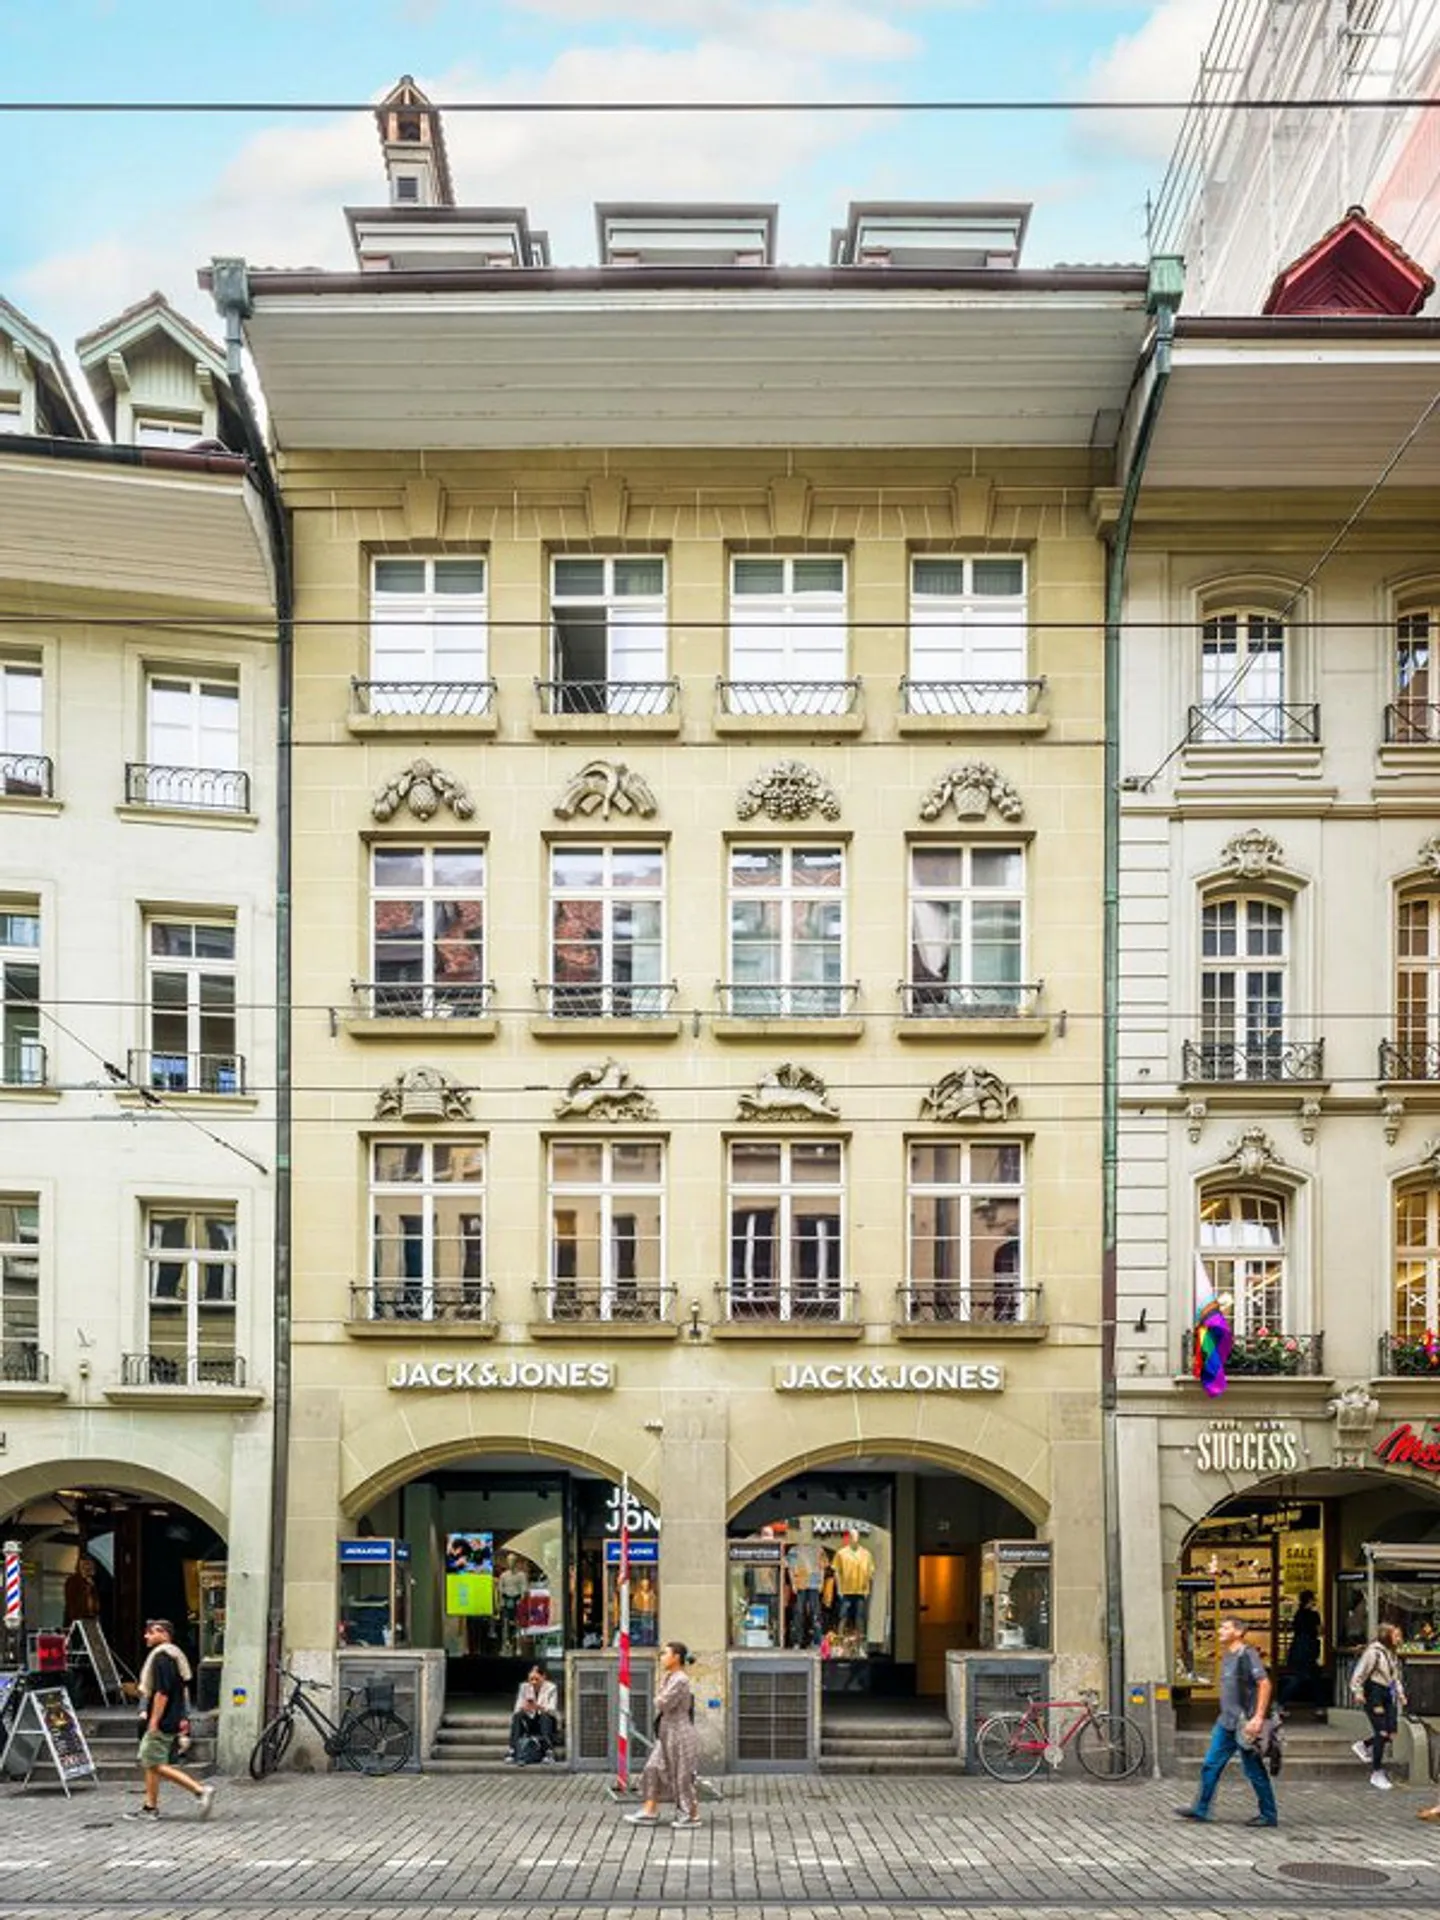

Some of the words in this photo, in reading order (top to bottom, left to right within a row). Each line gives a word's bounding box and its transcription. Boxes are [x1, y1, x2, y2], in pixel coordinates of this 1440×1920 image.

[391, 1363, 609, 1386] JACK&JONES
[781, 1365, 1000, 1388] JACK&JONES
[1197, 1432, 1297, 1470] SUCCESS
